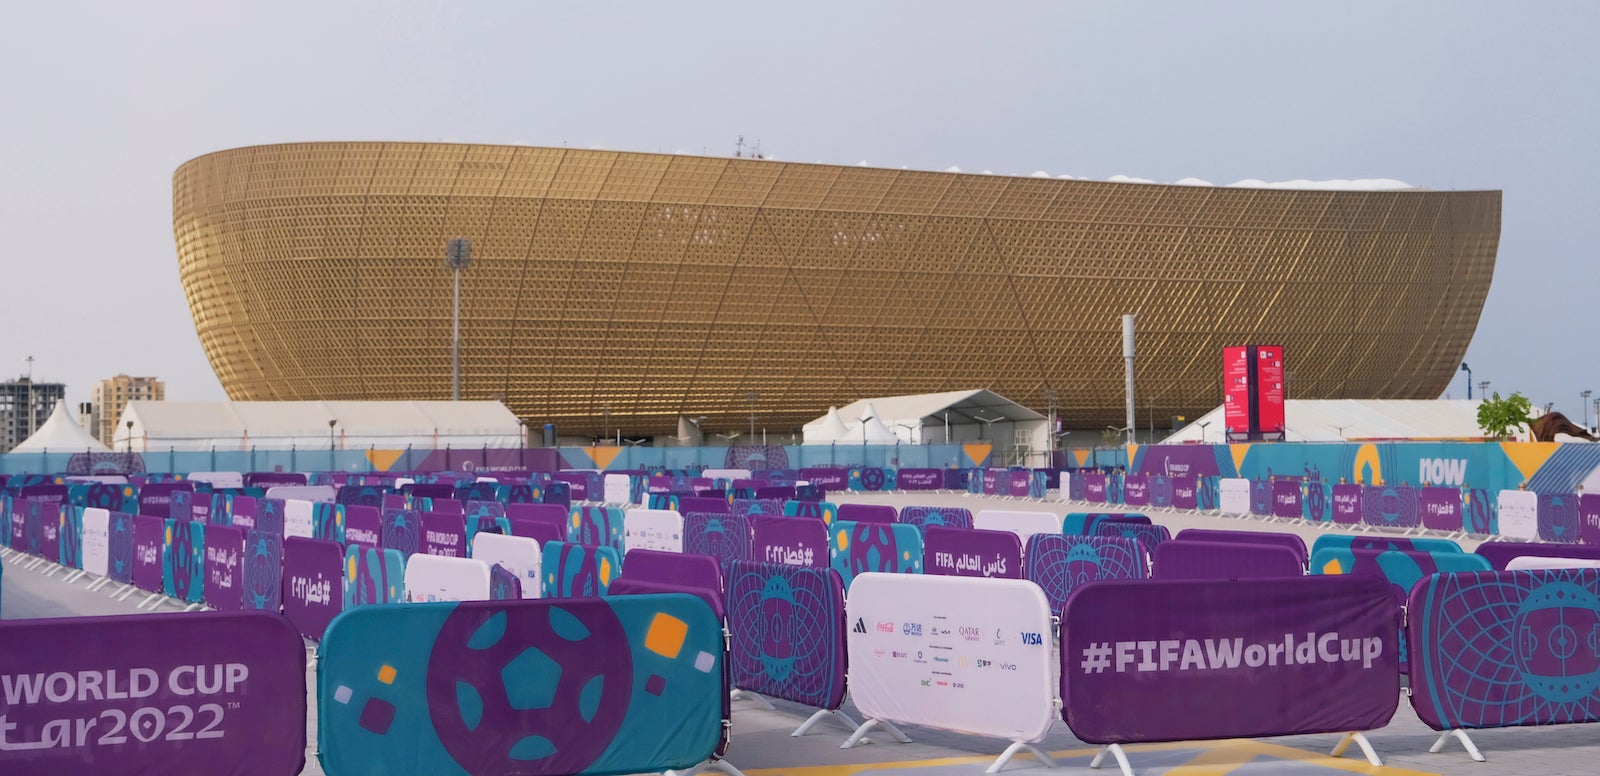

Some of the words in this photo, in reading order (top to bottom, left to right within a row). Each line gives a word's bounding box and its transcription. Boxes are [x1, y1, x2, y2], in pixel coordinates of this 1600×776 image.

[1419, 457, 1467, 485] now
[935, 552, 955, 569] FIFA
[955, 553, 981, 573] العالم
[982, 553, 1006, 577] كأس
[291, 572, 331, 607] #قطر٢٠٢٢
[959, 626, 980, 636] QATAR
[1020, 631, 1042, 646] VISA
[1081, 632, 1383, 674] #FIFAWorldCup
[1000, 662, 1016, 670] vivo
[1, 667, 159, 705] WORLD
[168, 663, 249, 696] CUP
